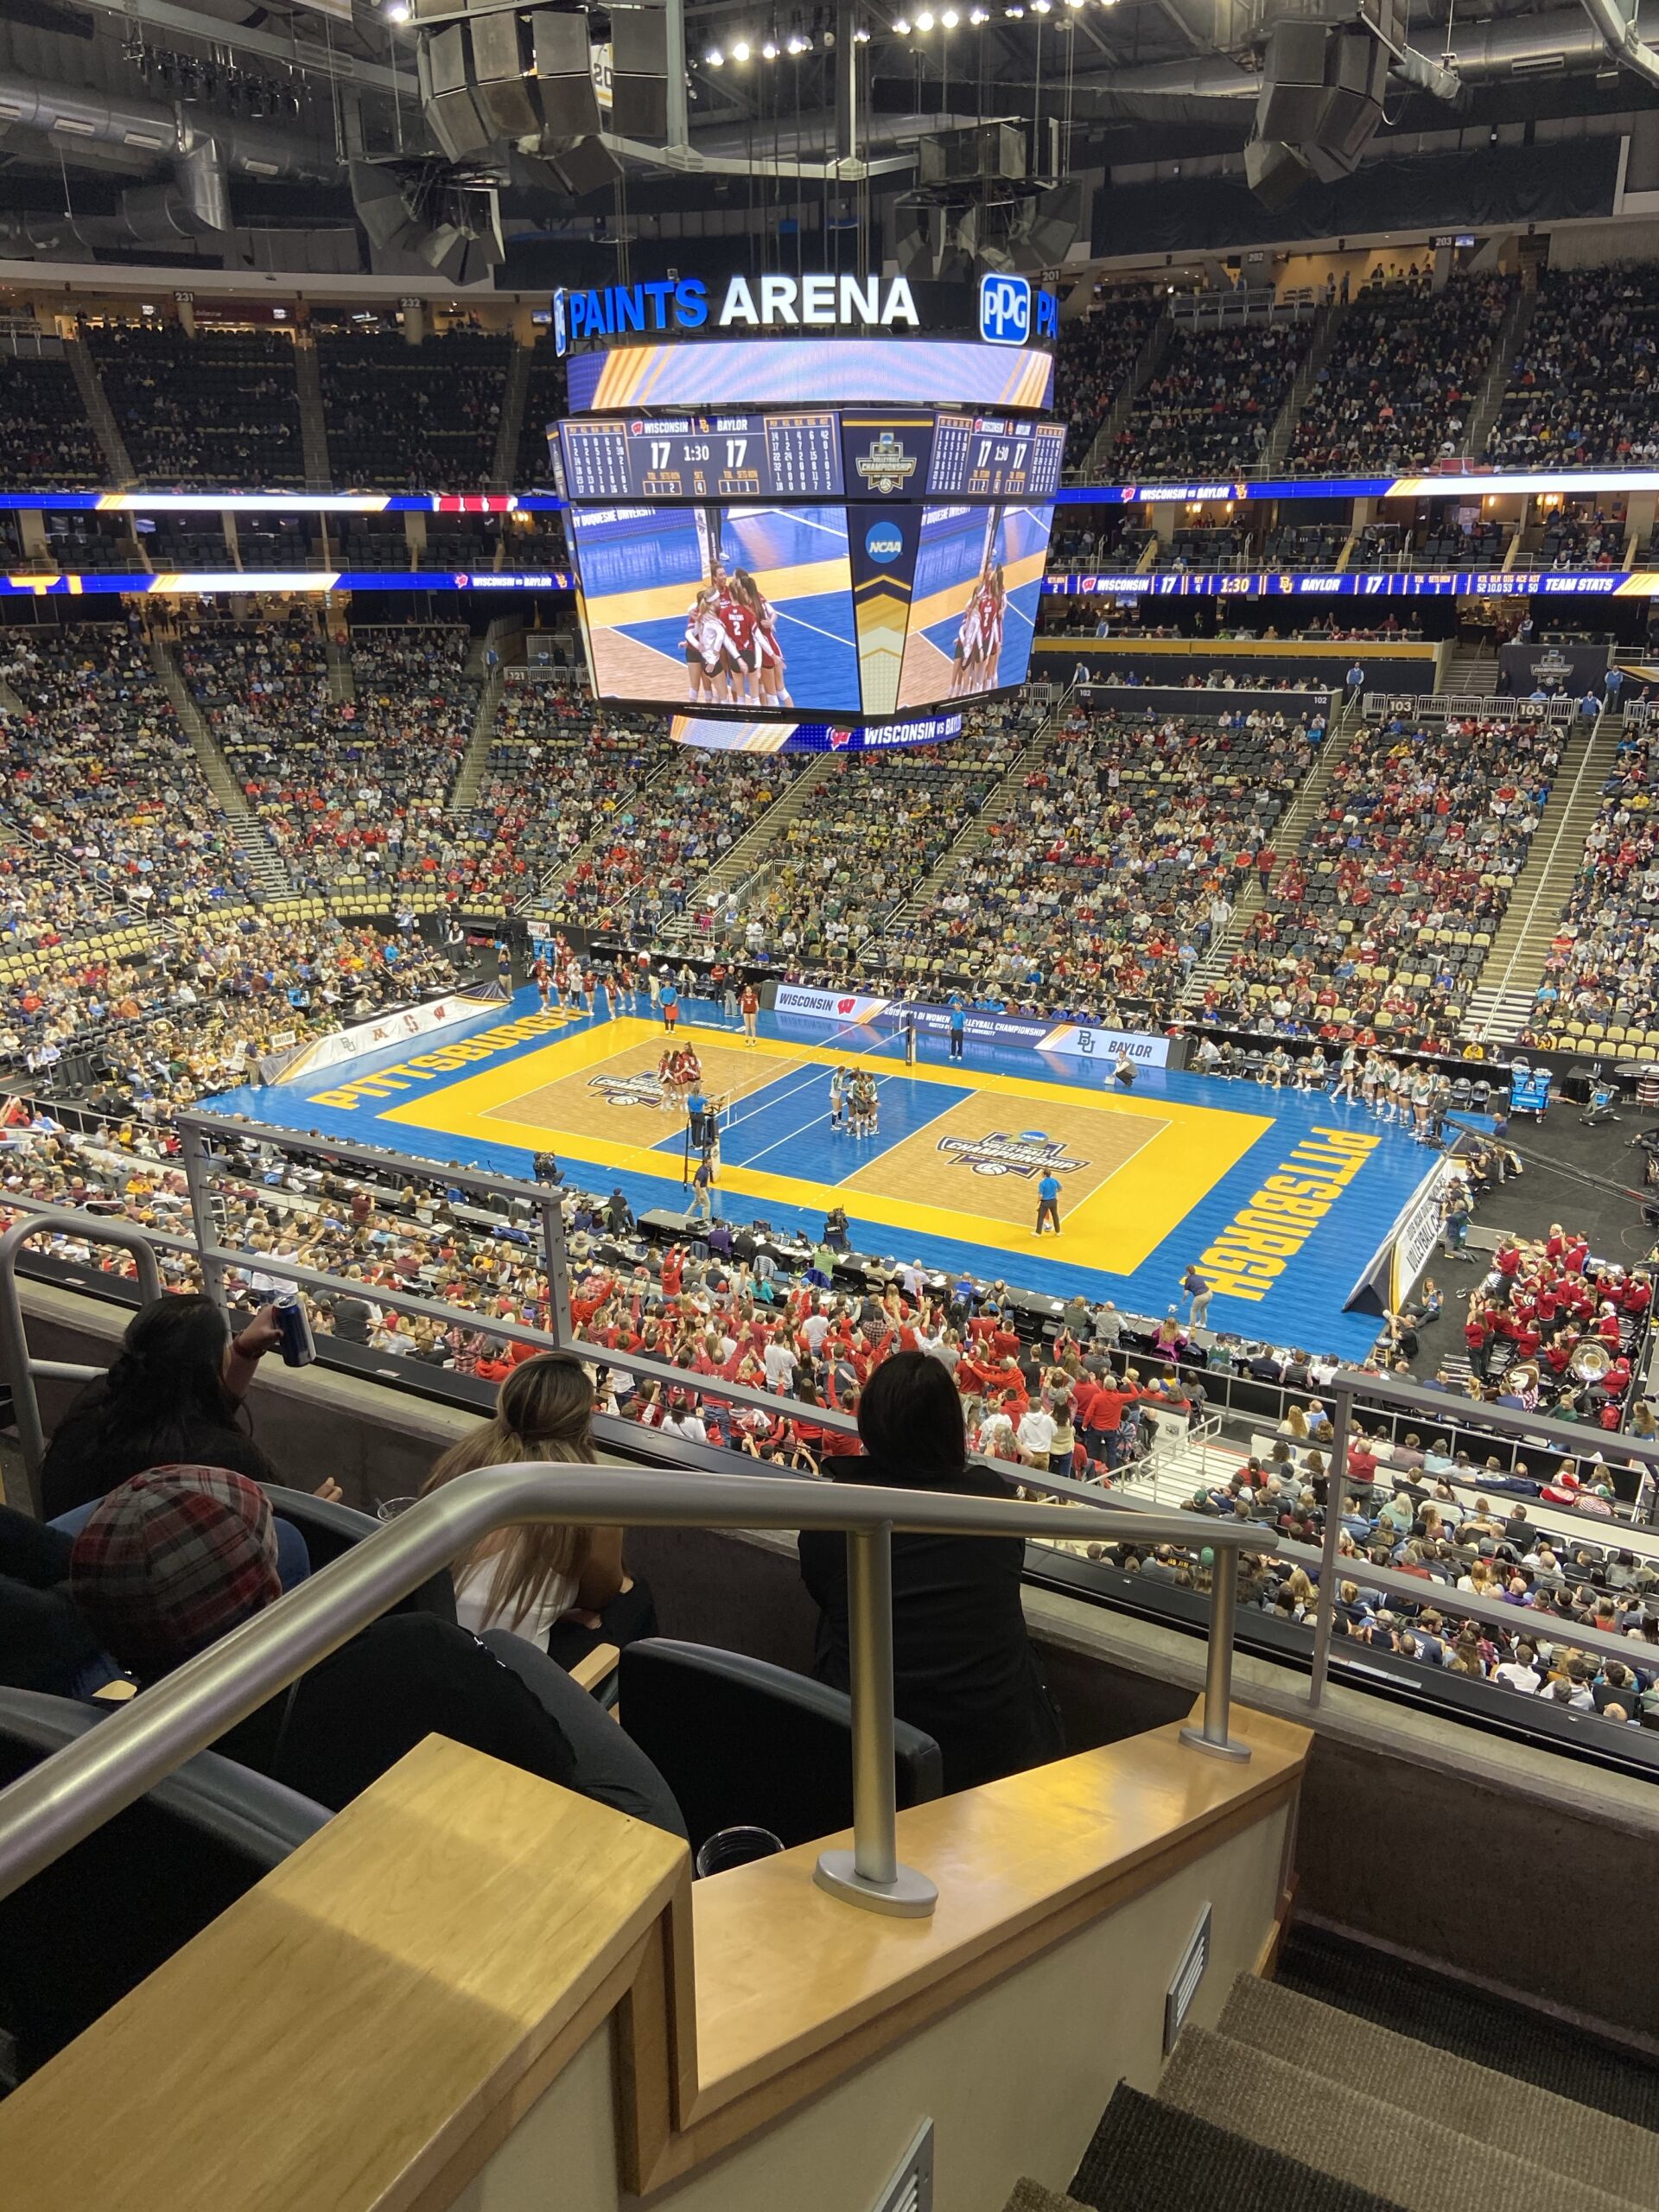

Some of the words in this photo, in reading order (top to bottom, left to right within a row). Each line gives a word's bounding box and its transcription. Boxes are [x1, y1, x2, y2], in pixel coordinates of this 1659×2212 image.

[1042, 270, 1060, 281] 201
[175, 292, 194, 302] 231
[401, 298, 421, 307] 232
[570, 279, 708, 339] PAINTS
[719, 274, 919, 326] ARENA
[983, 283, 1027, 335] PPG
[645, 422, 689, 433] WISCONSIN
[717, 419, 747, 431] BAYLOR
[651, 442, 671, 469] 17
[683, 445, 709, 461] 1:30
[727, 440, 747, 467] 17
[977, 441, 992, 467] 17
[1014, 443, 1027, 469] 17
[1140, 488, 1187, 499] WISCONSIN
[1197, 487, 1230, 499] BAYLOR
[869, 542, 901, 553] NCAA
[473, 577, 514, 587] WISCONSIN
[524, 577, 552, 587] BAYLOR
[1096, 578, 1149, 591] WISCONSIN
[1160, 577, 1177, 594] 17
[1220, 578, 1249, 593] 1:30
[1300, 579, 1340, 591] BAYLOR
[1365, 576, 1383, 594] 17
[1477, 584, 1486, 593] 52
[1487, 584, 1502, 593] 10.0
[1503, 583, 1512, 592] 53
[1528, 583, 1538, 593] 50
[1545, 578, 1576, 591] TEAM
[1577, 578, 1614, 591] STATS
[734, 621, 741, 635] 2
[1389, 700, 1412, 712] 103
[1521, 705, 1544, 715] 103
[864, 721, 936, 745] WISCONSIN
[779, 993, 834, 1012] WISCONSIN
[995, 1023, 1046, 1037] CHAMPIONSHIP
[1108, 1040, 1153, 1058] BAYLOR
[306, 1006, 590, 1110] PITTSBURGH
[947, 1141, 1077, 1170] CHAMPIONSHIP
[982, 1141, 1052, 1159] VOLLEYBALL
[1179, 1127, 1382, 1302] PITTSBURGH
[1406, 1220, 1434, 1274] VOLLEYBALL
